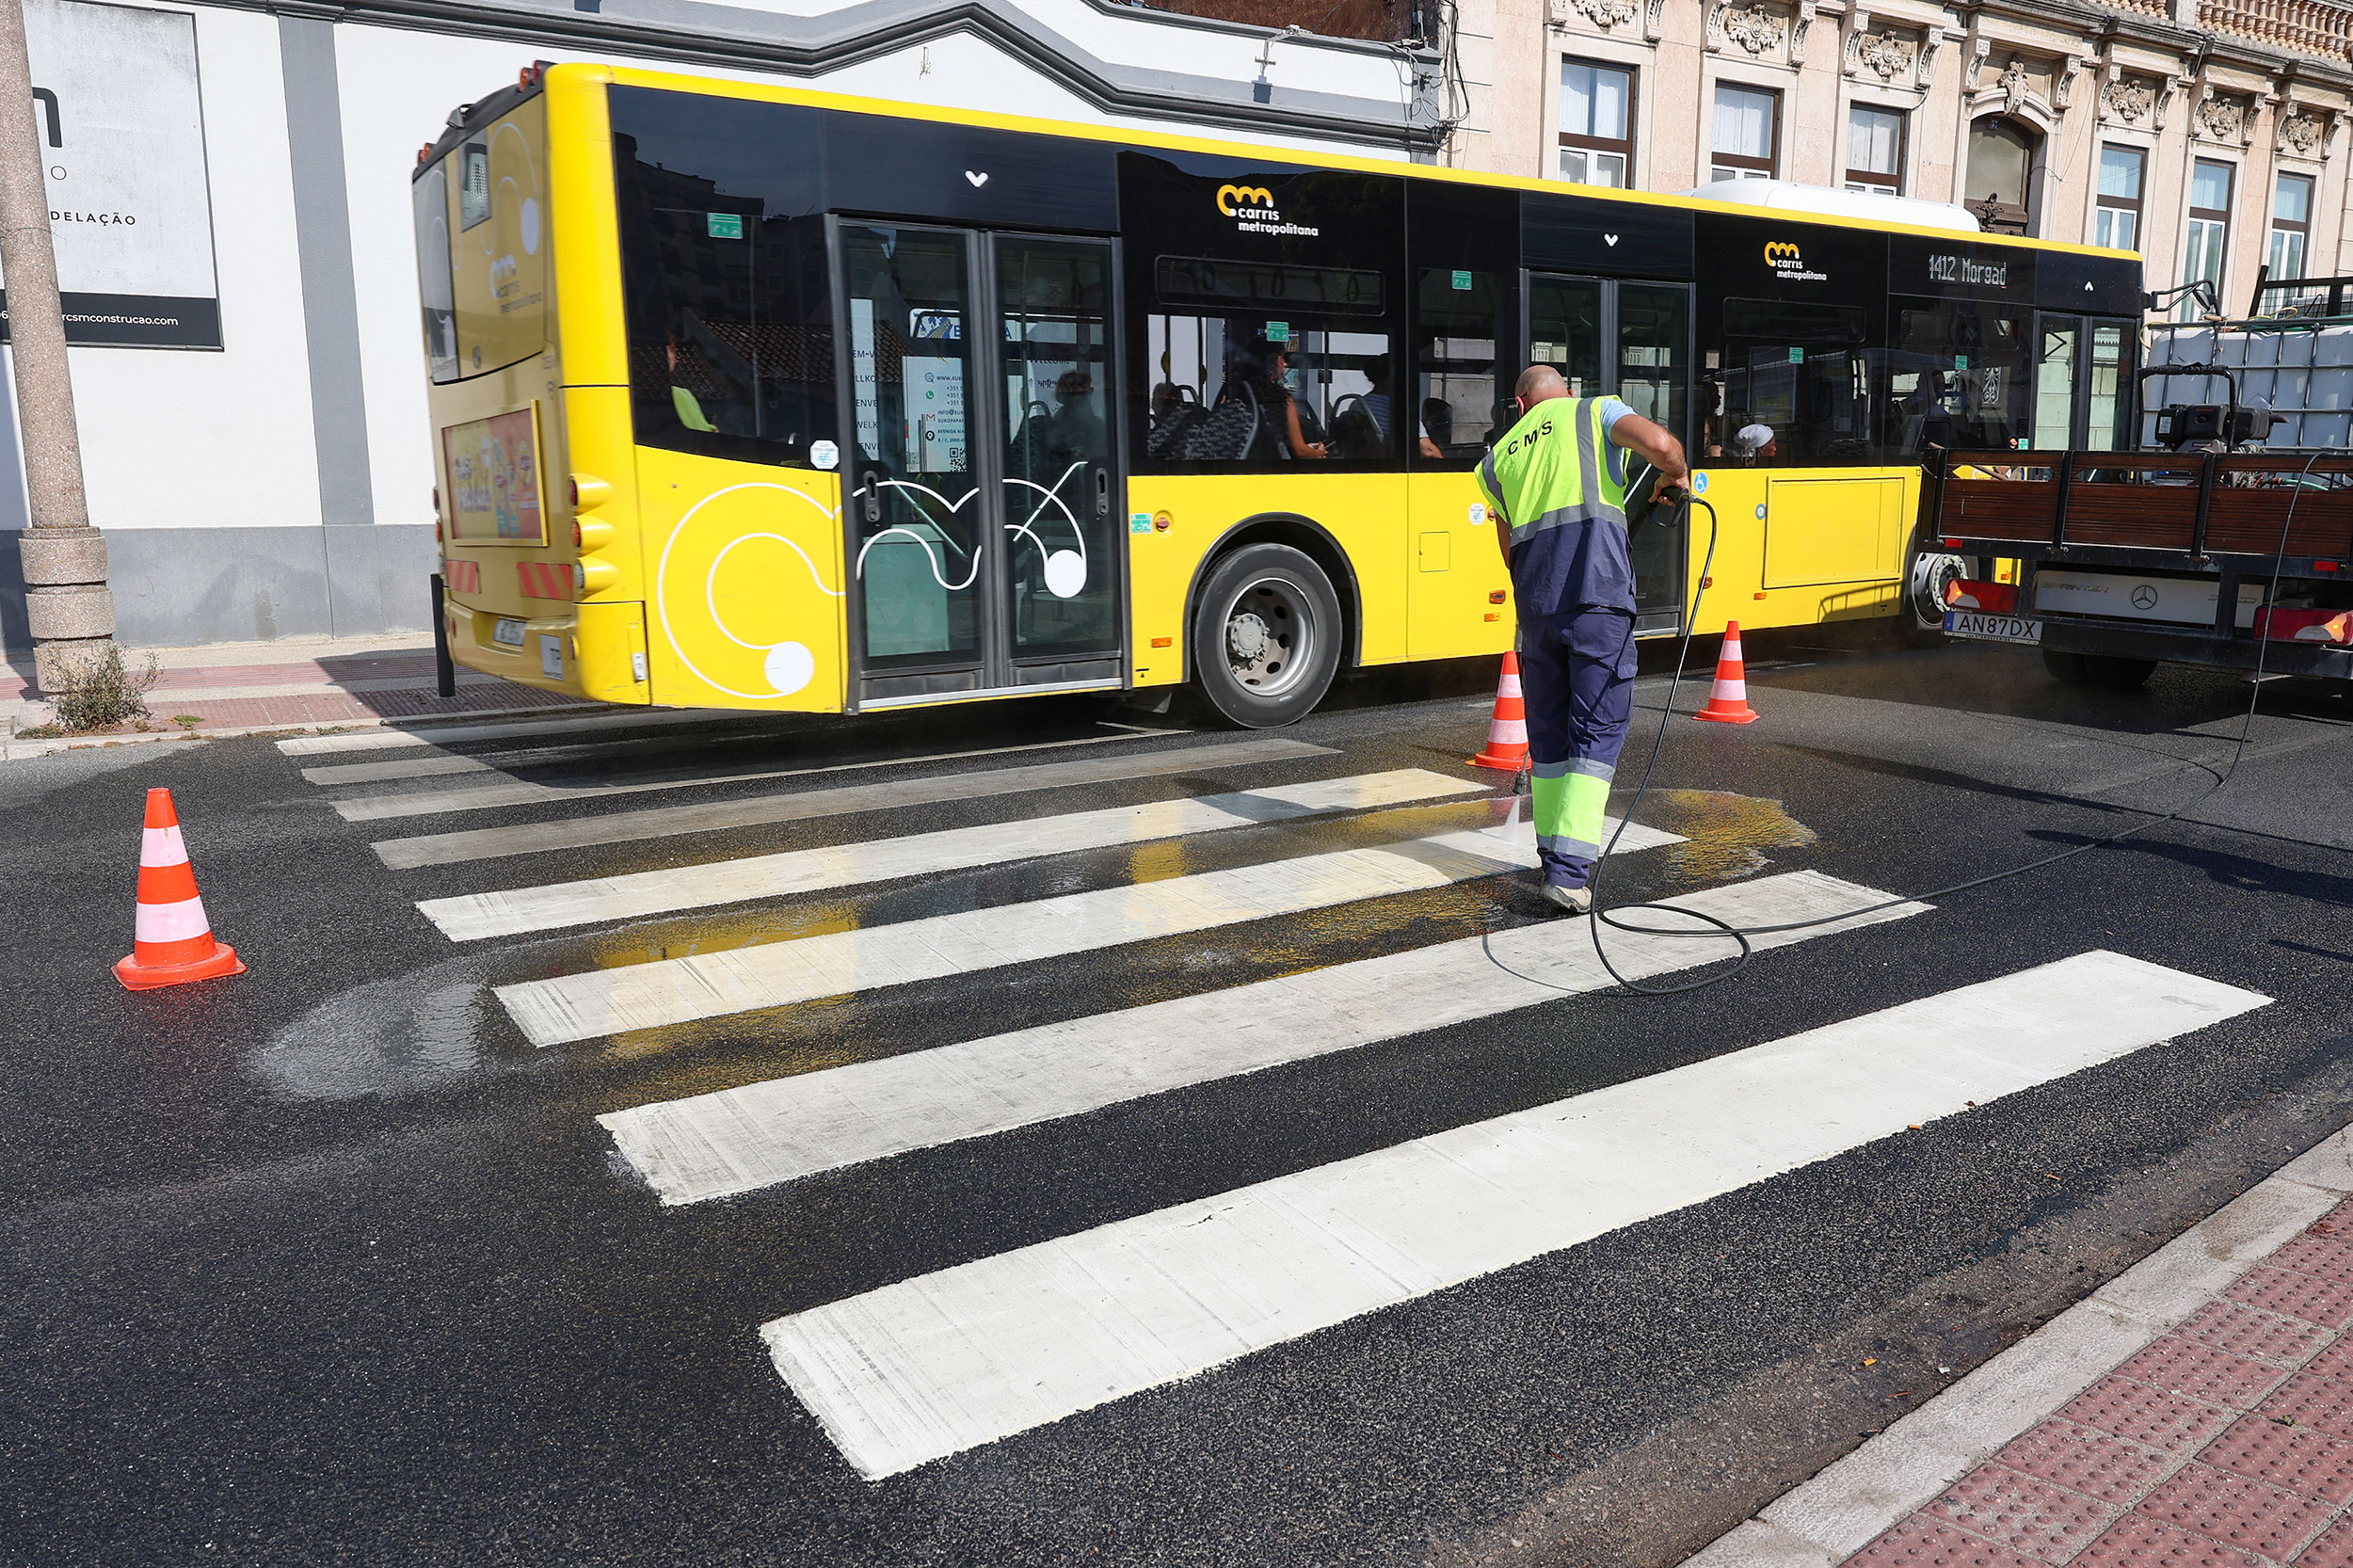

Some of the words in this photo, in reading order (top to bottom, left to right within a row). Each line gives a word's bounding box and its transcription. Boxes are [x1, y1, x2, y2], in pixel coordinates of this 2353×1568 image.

[51, 210, 136, 226] DELAÇÃO
[1238, 208, 1280, 221] carris
[1238, 221, 1319, 236] metropolitana
[1777, 260, 1803, 269] carris
[1961, 258, 2007, 285] Morgad
[1777, 270, 1827, 280] metropolitana
[61, 312, 179, 326] rcsmconstrucao.com
[1959, 615, 2037, 638] AN87DX
